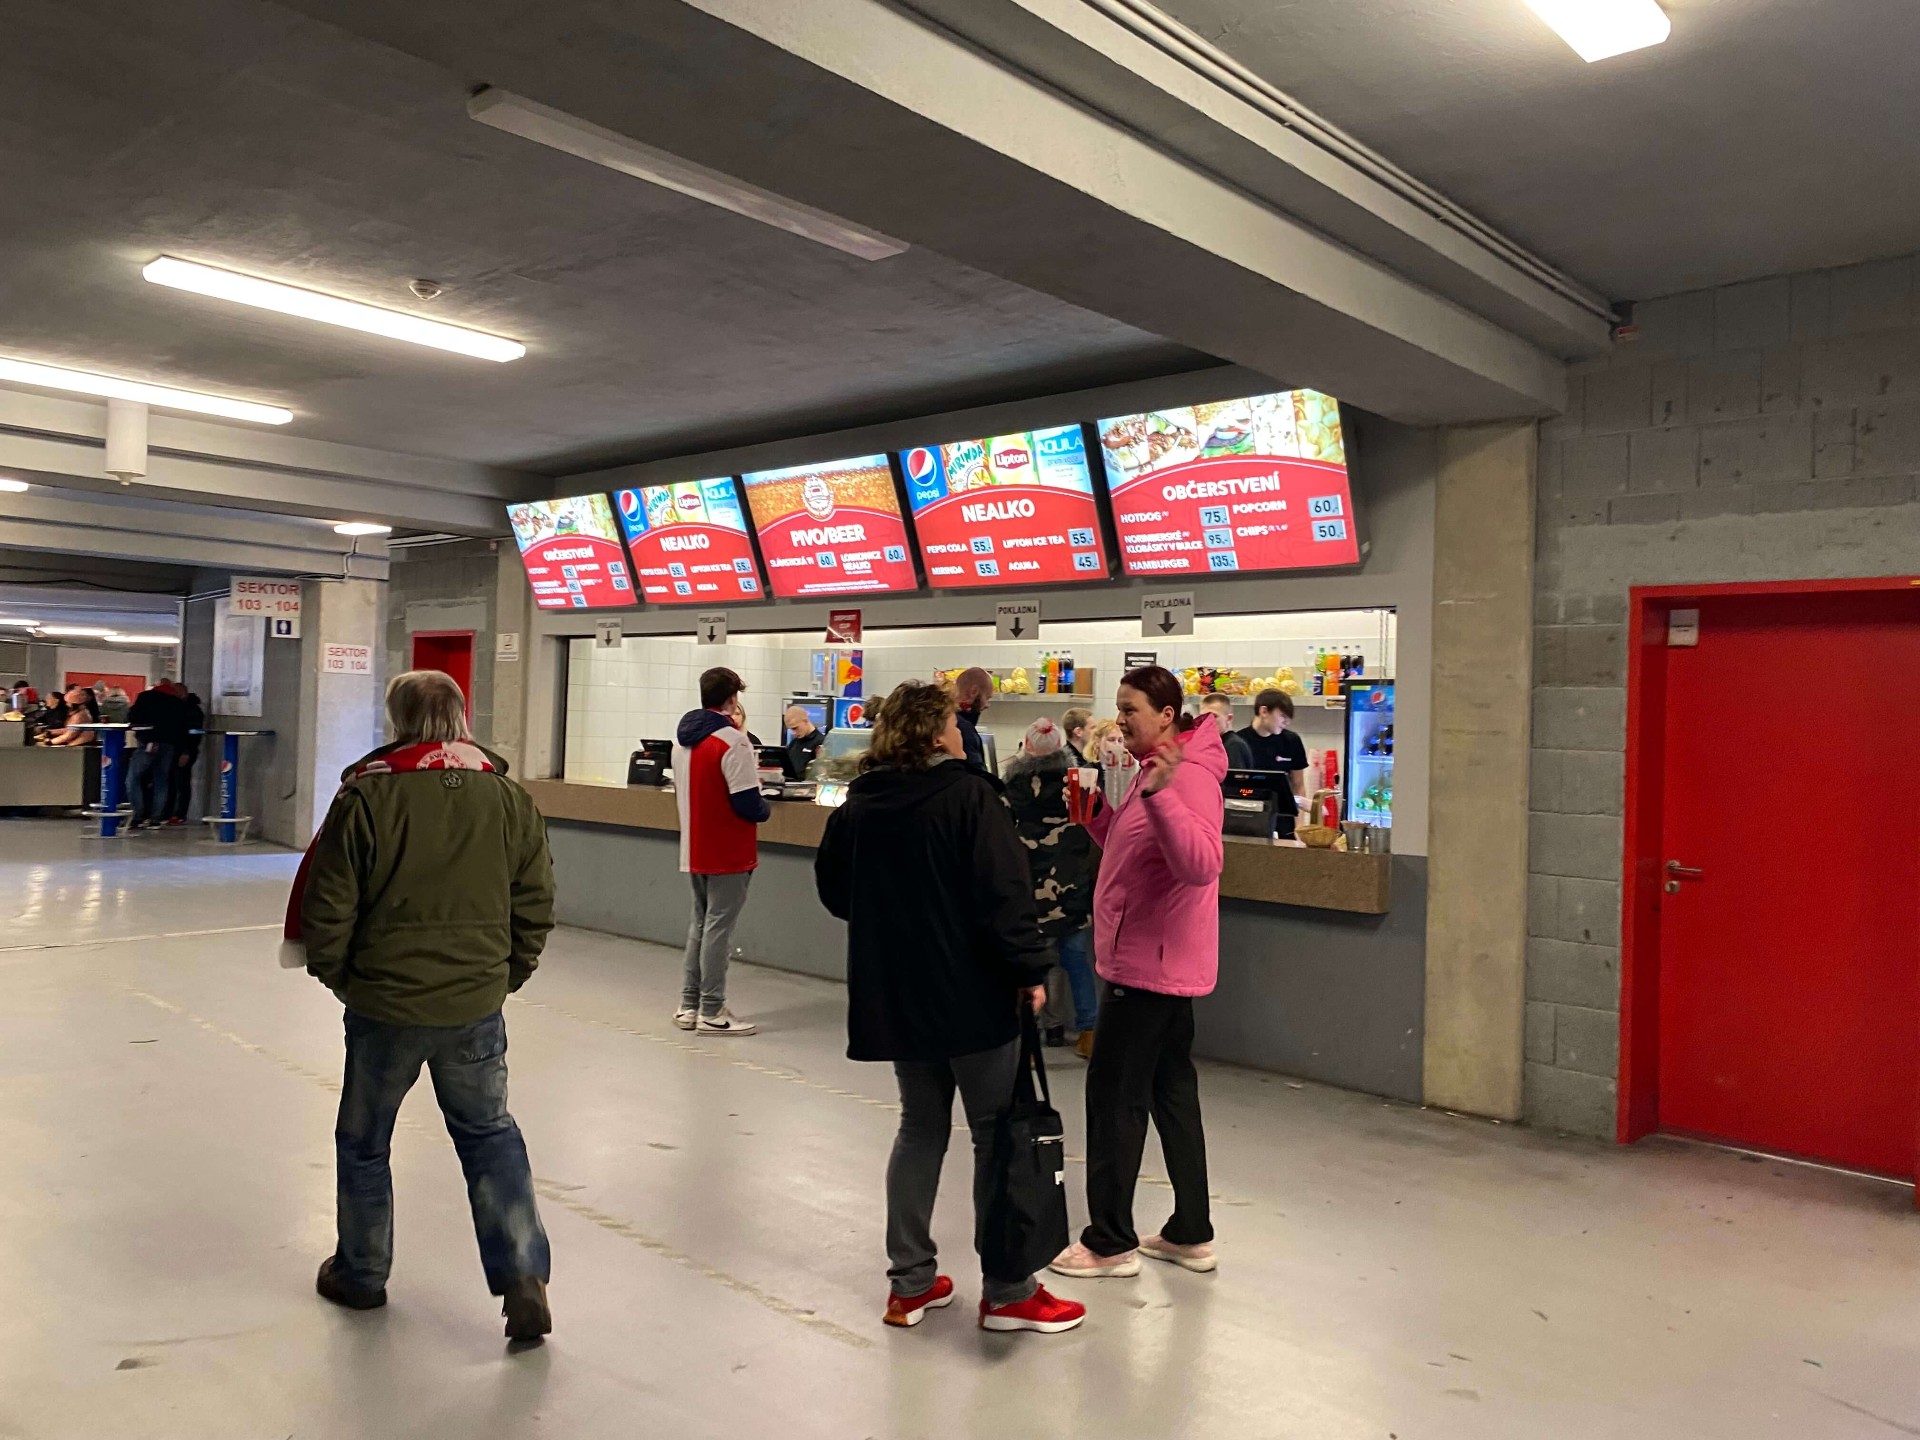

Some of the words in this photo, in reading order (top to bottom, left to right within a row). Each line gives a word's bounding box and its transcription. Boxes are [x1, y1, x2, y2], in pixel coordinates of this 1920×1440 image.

[1038, 436, 1084, 455] AQUILA
[948, 444, 984, 480] MIRINDA
[996, 452, 1027, 467] Lipton
[1162, 470, 1281, 502] OBČERSTVENÍ
[917, 489, 940, 501] pepsi
[961, 498, 1036, 523] NEALKO
[1232, 500, 1287, 514] POPCORN
[1120, 511, 1162, 523] HOTDOG
[790, 524, 867, 547] PIVO/BEER
[1236, 525, 1268, 537] CHIPS
[660, 533, 710, 552] NEALKO
[926, 544, 946, 554] PEPSI
[946, 543, 968, 553] COLA
[1003, 537, 1032, 549] LIPTON
[1033, 536, 1047, 547] ICE
[1047, 535, 1066, 546] TEA
[1009, 560, 1040, 571] AQUILA
[1129, 558, 1190, 570] HAMBURGER
[237, 582, 300, 596] SEKTOR
[237, 599, 262, 611] 103
[275, 601, 299, 613] 104
[998, 606, 1038, 615] POKLADNA
[1144, 597, 1192, 610] POKLADNA
[327, 647, 368, 658] SEKTOR
[327, 659, 344, 669] 103
[350, 660, 368, 670] 104
